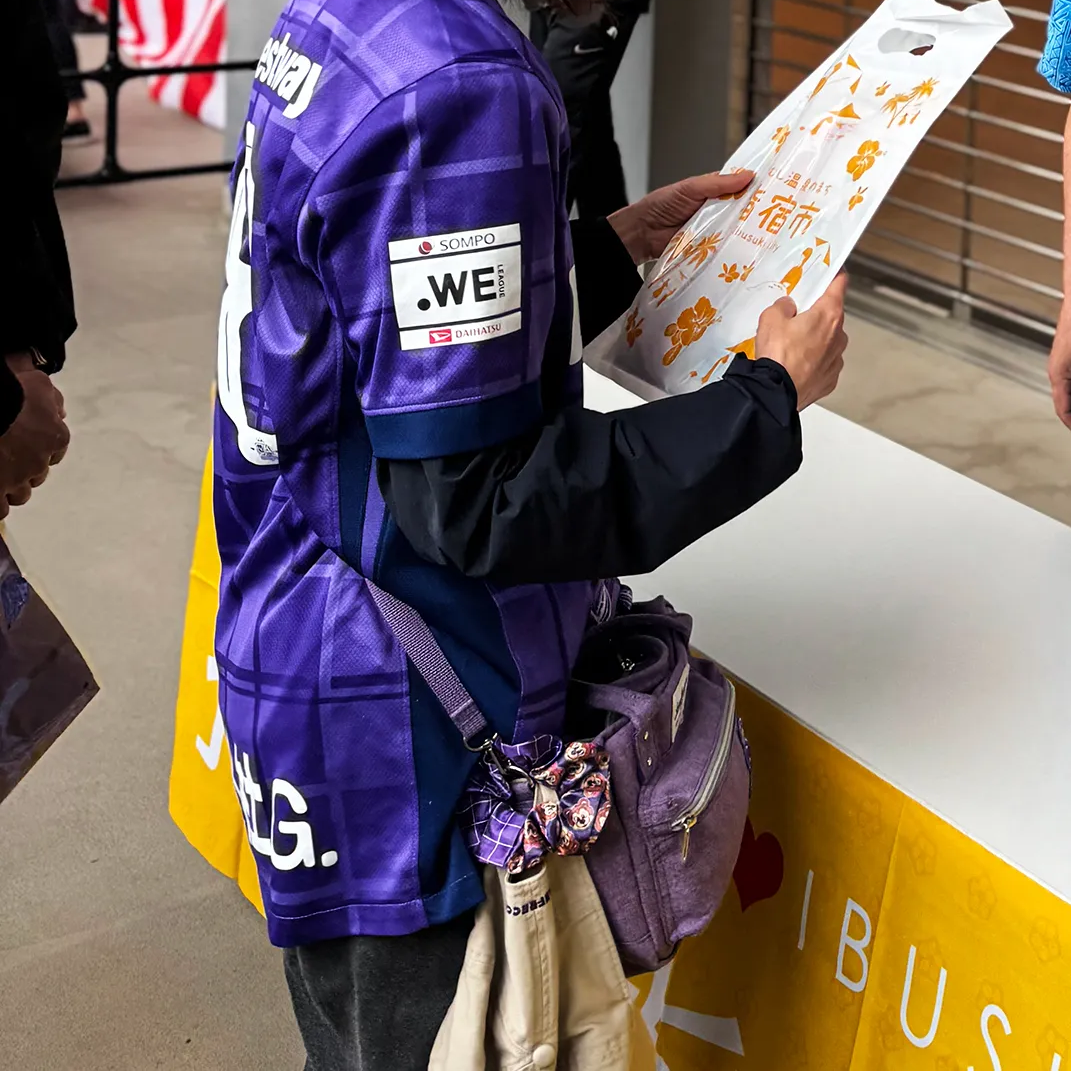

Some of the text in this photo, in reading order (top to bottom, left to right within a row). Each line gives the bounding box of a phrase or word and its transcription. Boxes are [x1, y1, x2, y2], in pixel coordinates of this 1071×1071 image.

[439, 232, 496, 252] SOMPO
[497, 263, 506, 299] LEAGUE
[455, 322, 502, 339] DAIHATSU
[797, 868, 1063, 1071] IBUS
